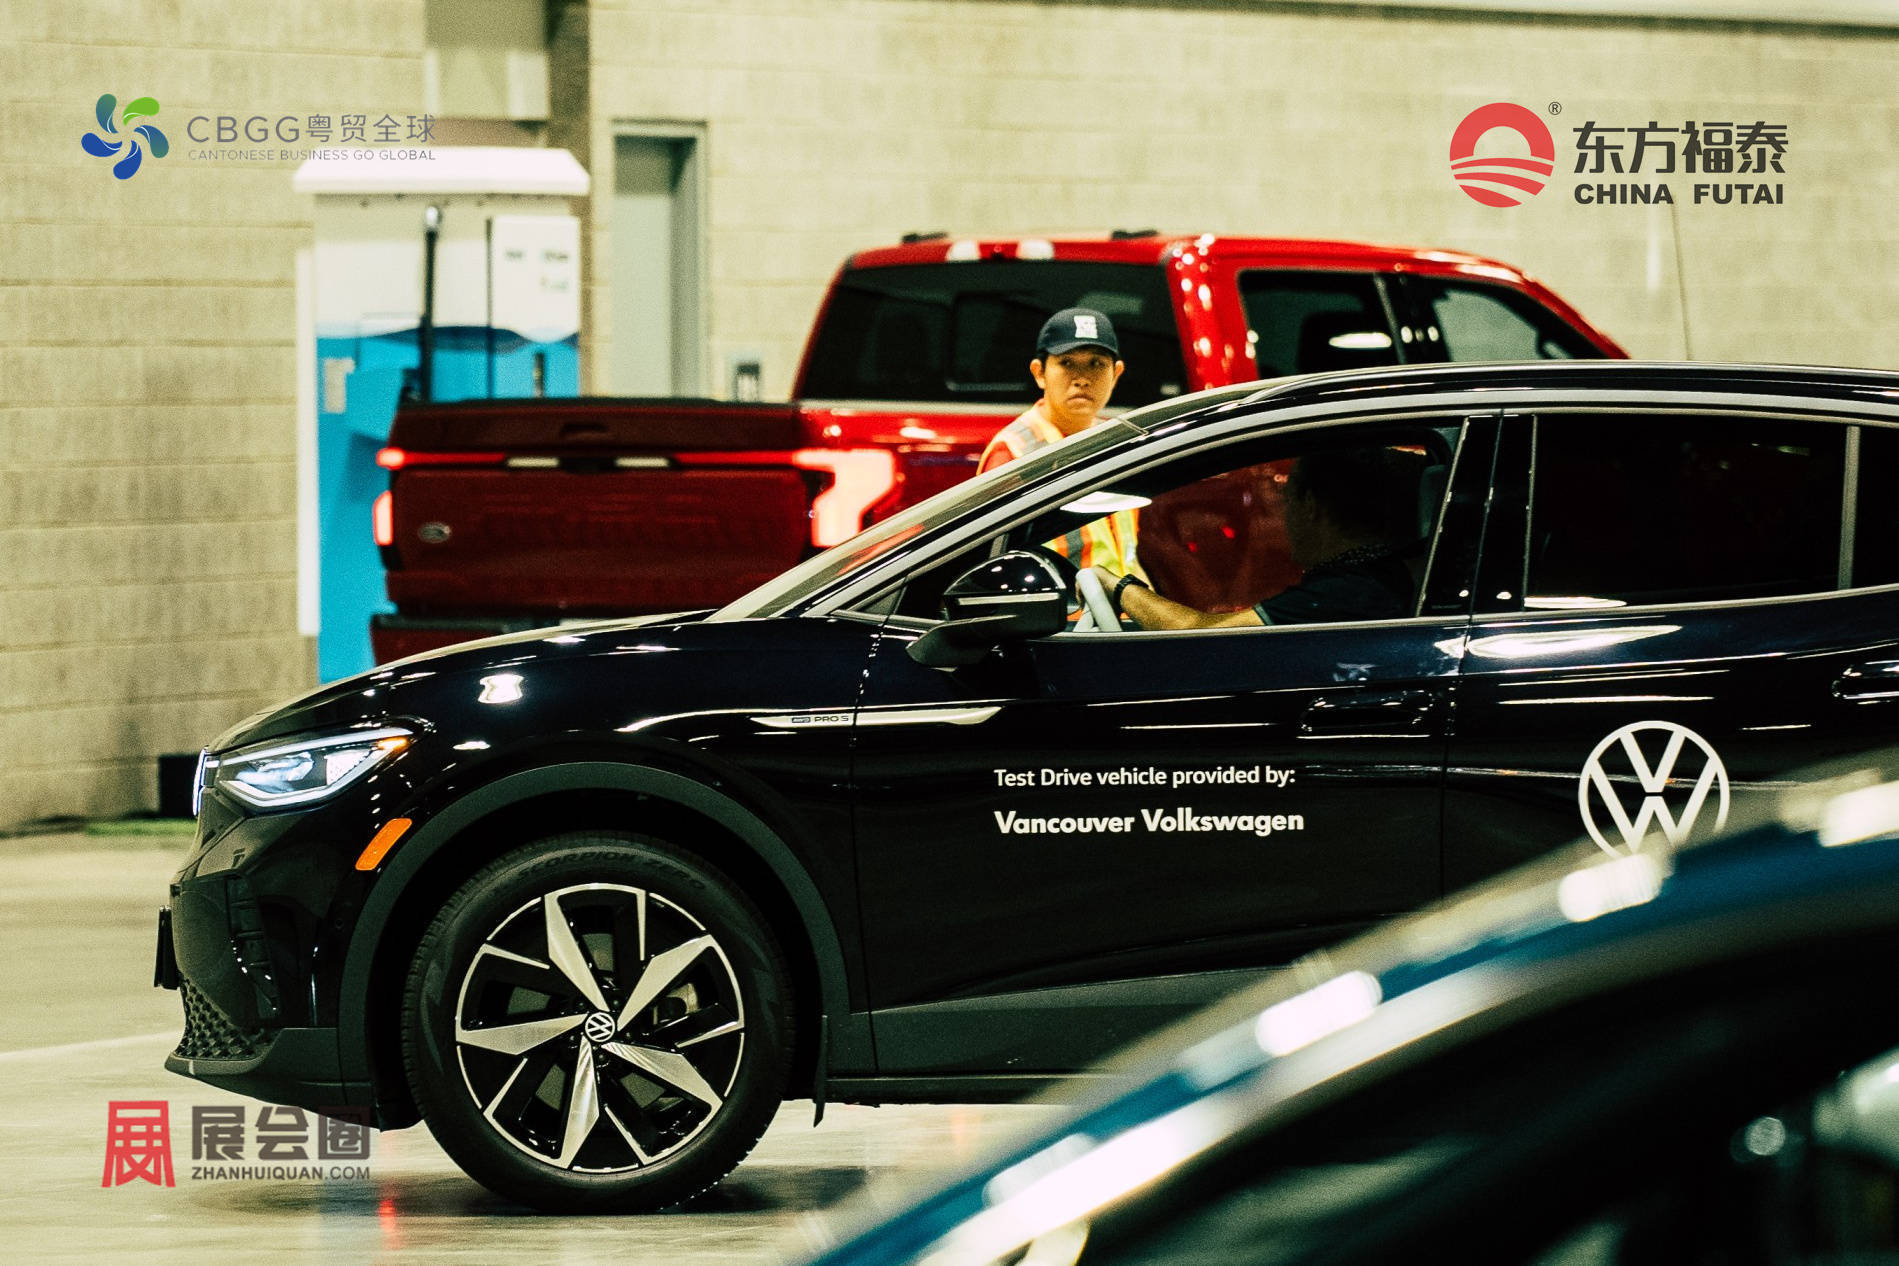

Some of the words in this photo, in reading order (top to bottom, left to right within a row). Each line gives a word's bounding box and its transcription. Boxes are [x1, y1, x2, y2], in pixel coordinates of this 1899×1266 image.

[994, 769, 1035, 786] Test
[1041, 768, 1092, 786] Drive
[1097, 767, 1167, 785] vehicle
[1173, 766, 1259, 788] provided
[1266, 765, 1296, 788] by:
[994, 811, 1135, 834] Vancouver
[1141, 807, 1304, 837] Volkswagen
